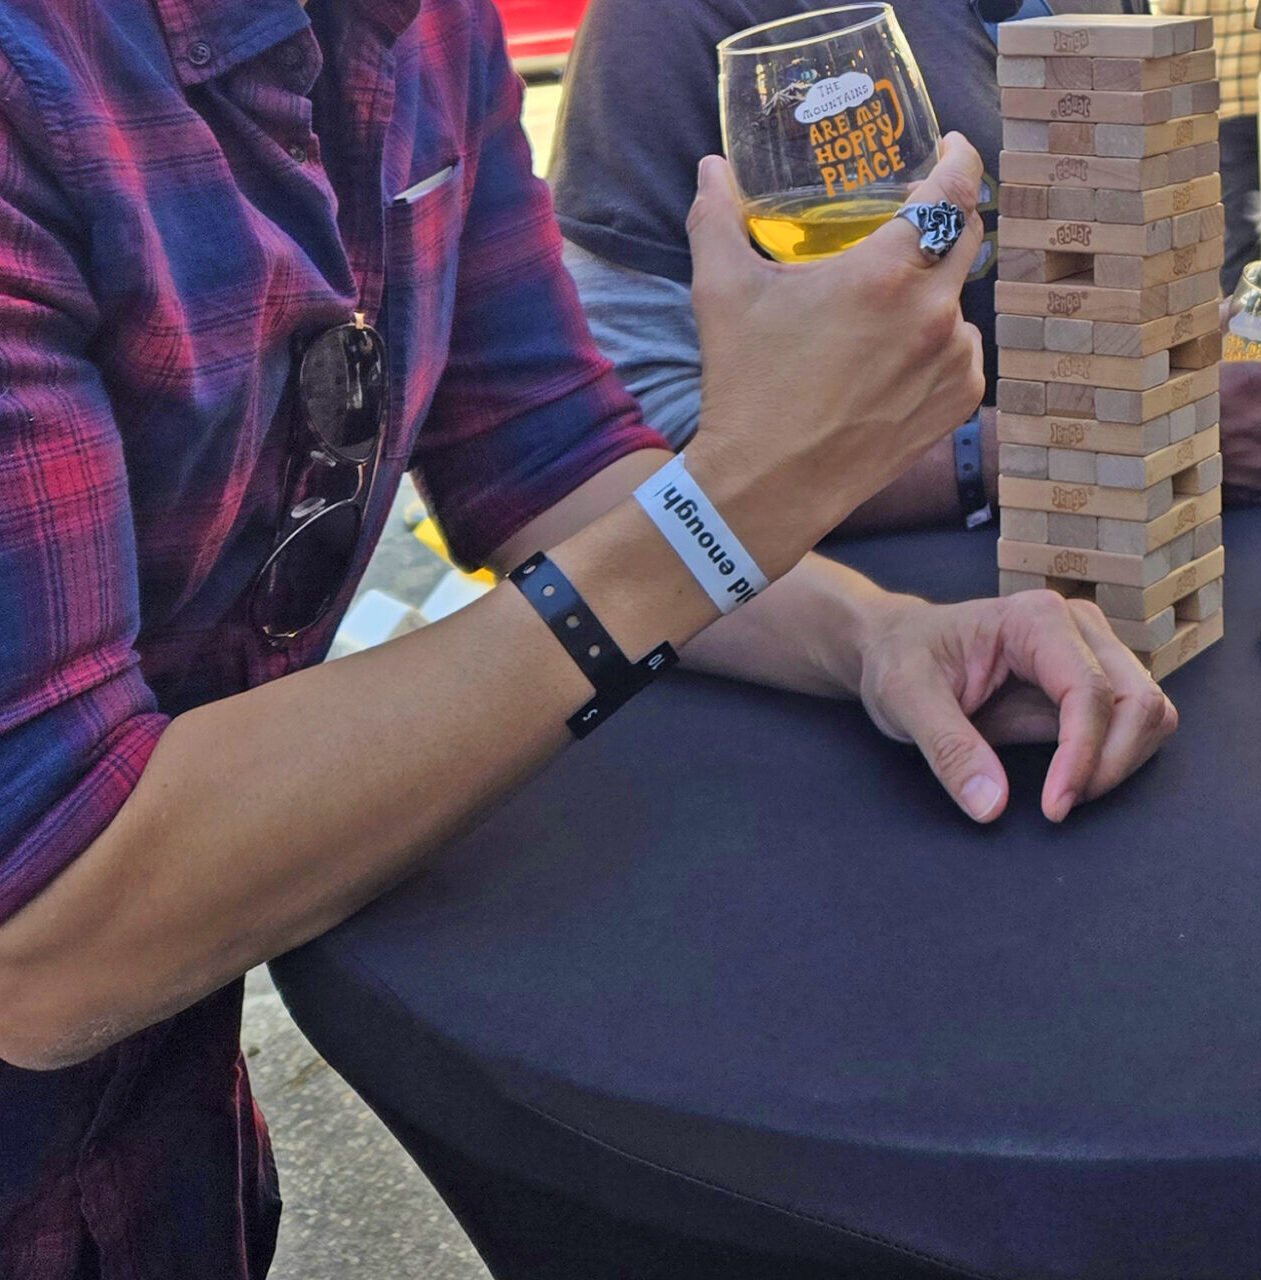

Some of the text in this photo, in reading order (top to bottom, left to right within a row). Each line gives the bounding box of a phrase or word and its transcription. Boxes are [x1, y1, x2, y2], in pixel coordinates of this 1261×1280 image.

[1053, 29, 1089, 52] Jenga
[802, 84, 869, 120] MOUNTAINS
[817, 81, 840, 97] THE
[809, 113, 850, 146] ARE
[814, 113, 893, 164] HOPPY
[821, 145, 905, 197] PLACE
[1047, 291, 1082, 314] Jenga
[1052, 486, 1088, 511] Jenga
